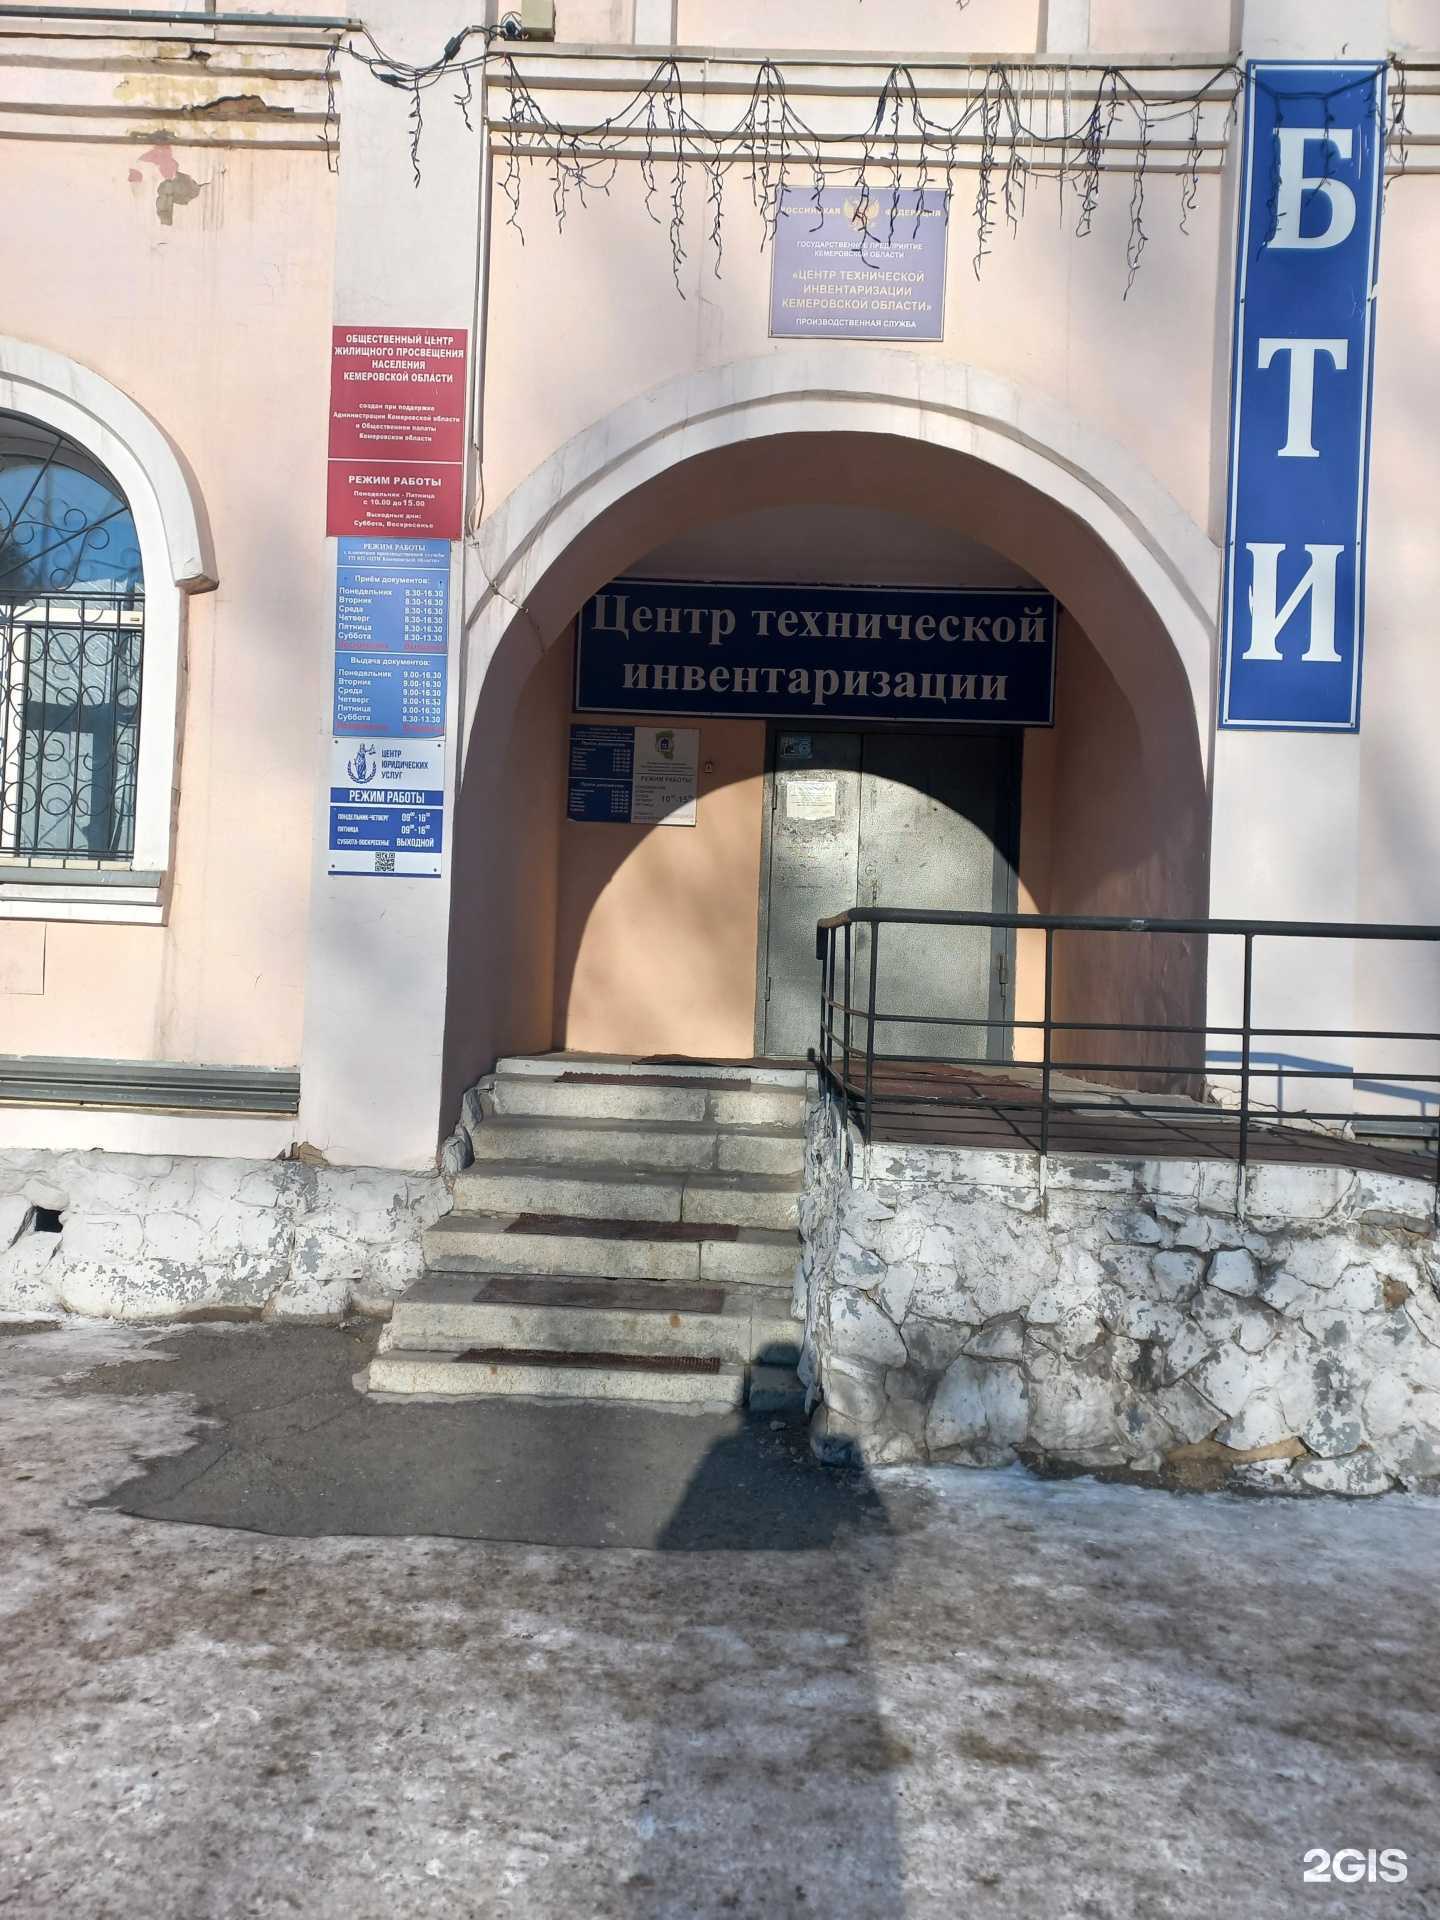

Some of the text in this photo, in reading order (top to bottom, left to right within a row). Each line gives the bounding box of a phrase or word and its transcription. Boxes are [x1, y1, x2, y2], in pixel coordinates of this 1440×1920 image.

[840, 270, 924, 282] ТЕХНИЧЕСКОЙ
[804, 284, 912, 297] ИНВЕНТАРИЗАЦИИ
[782, 298, 932, 312] КЕМЕРОВСКОЙ ОБЛАСТИ»
[796, 318, 916, 328] ПРОИЗВОДСТВЕННАЯ СЛУЖБА
[346, 334, 454, 346] ОБЩЕСТВЕННЫЙ ЦЕНТР
[335, 346, 464, 358] ЖИЛИЩНОГО ПРОСВЕЩЕНИЯ
[372, 360, 425, 369] НАСЕЛЕНИЯ
[344, 371, 453, 383] КЕМЕРОВСКОЙ ОБЛАСТИ
[1243, 127, 1357, 662] БТИ
[348, 475, 441, 486] РЕЖИМ РАБОТЫ
[339, 587, 392, 596] Понедельник
[339, 597, 372, 605] Вторник
[338, 606, 364, 614] Среда
[338, 614, 369, 623] Четверг
[592, 594, 1047, 645] Центр технической
[338, 623, 372, 632] Пятница
[338, 632, 372, 641] Суббота
[350, 656, 381, 666] Выдача
[338, 668, 392, 677] Понедельник
[338, 677, 371, 686] Вторник
[622, 661, 1008, 705] инвентаризации
[338, 687, 363, 695] Среда
[338, 696, 369, 704] Четверг
[337, 704, 371, 713] Пятница
[337, 713, 371, 722] Суббота
[381, 750, 402, 758] ЦЕНТР
[381, 760, 428, 770] ЮРИДИЧЕСКИХ
[381, 771, 403, 779] УСЛУГ
[350, 790, 425, 804] РЕЖИМ РАБОТЫ
[396, 838, 434, 848] ВЫХОДНОЙ
